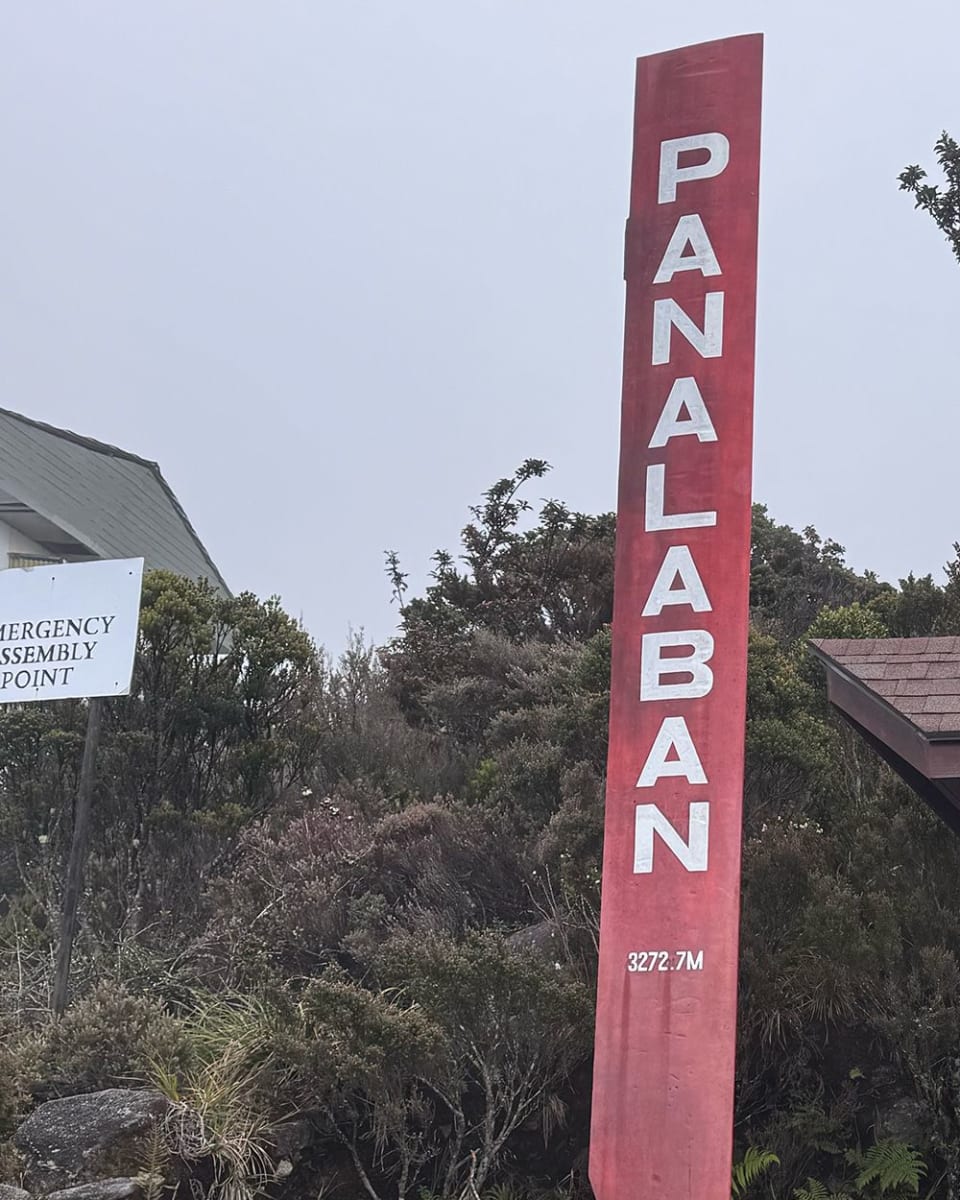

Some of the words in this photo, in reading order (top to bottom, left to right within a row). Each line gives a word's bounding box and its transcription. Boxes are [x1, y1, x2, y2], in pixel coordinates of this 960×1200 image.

[633, 132, 730, 874] PANALABAN
[0, 641, 98, 665] SSEMBLY
[0, 667, 74, 689] POINT
[627, 950, 704, 972] 3272.7M
